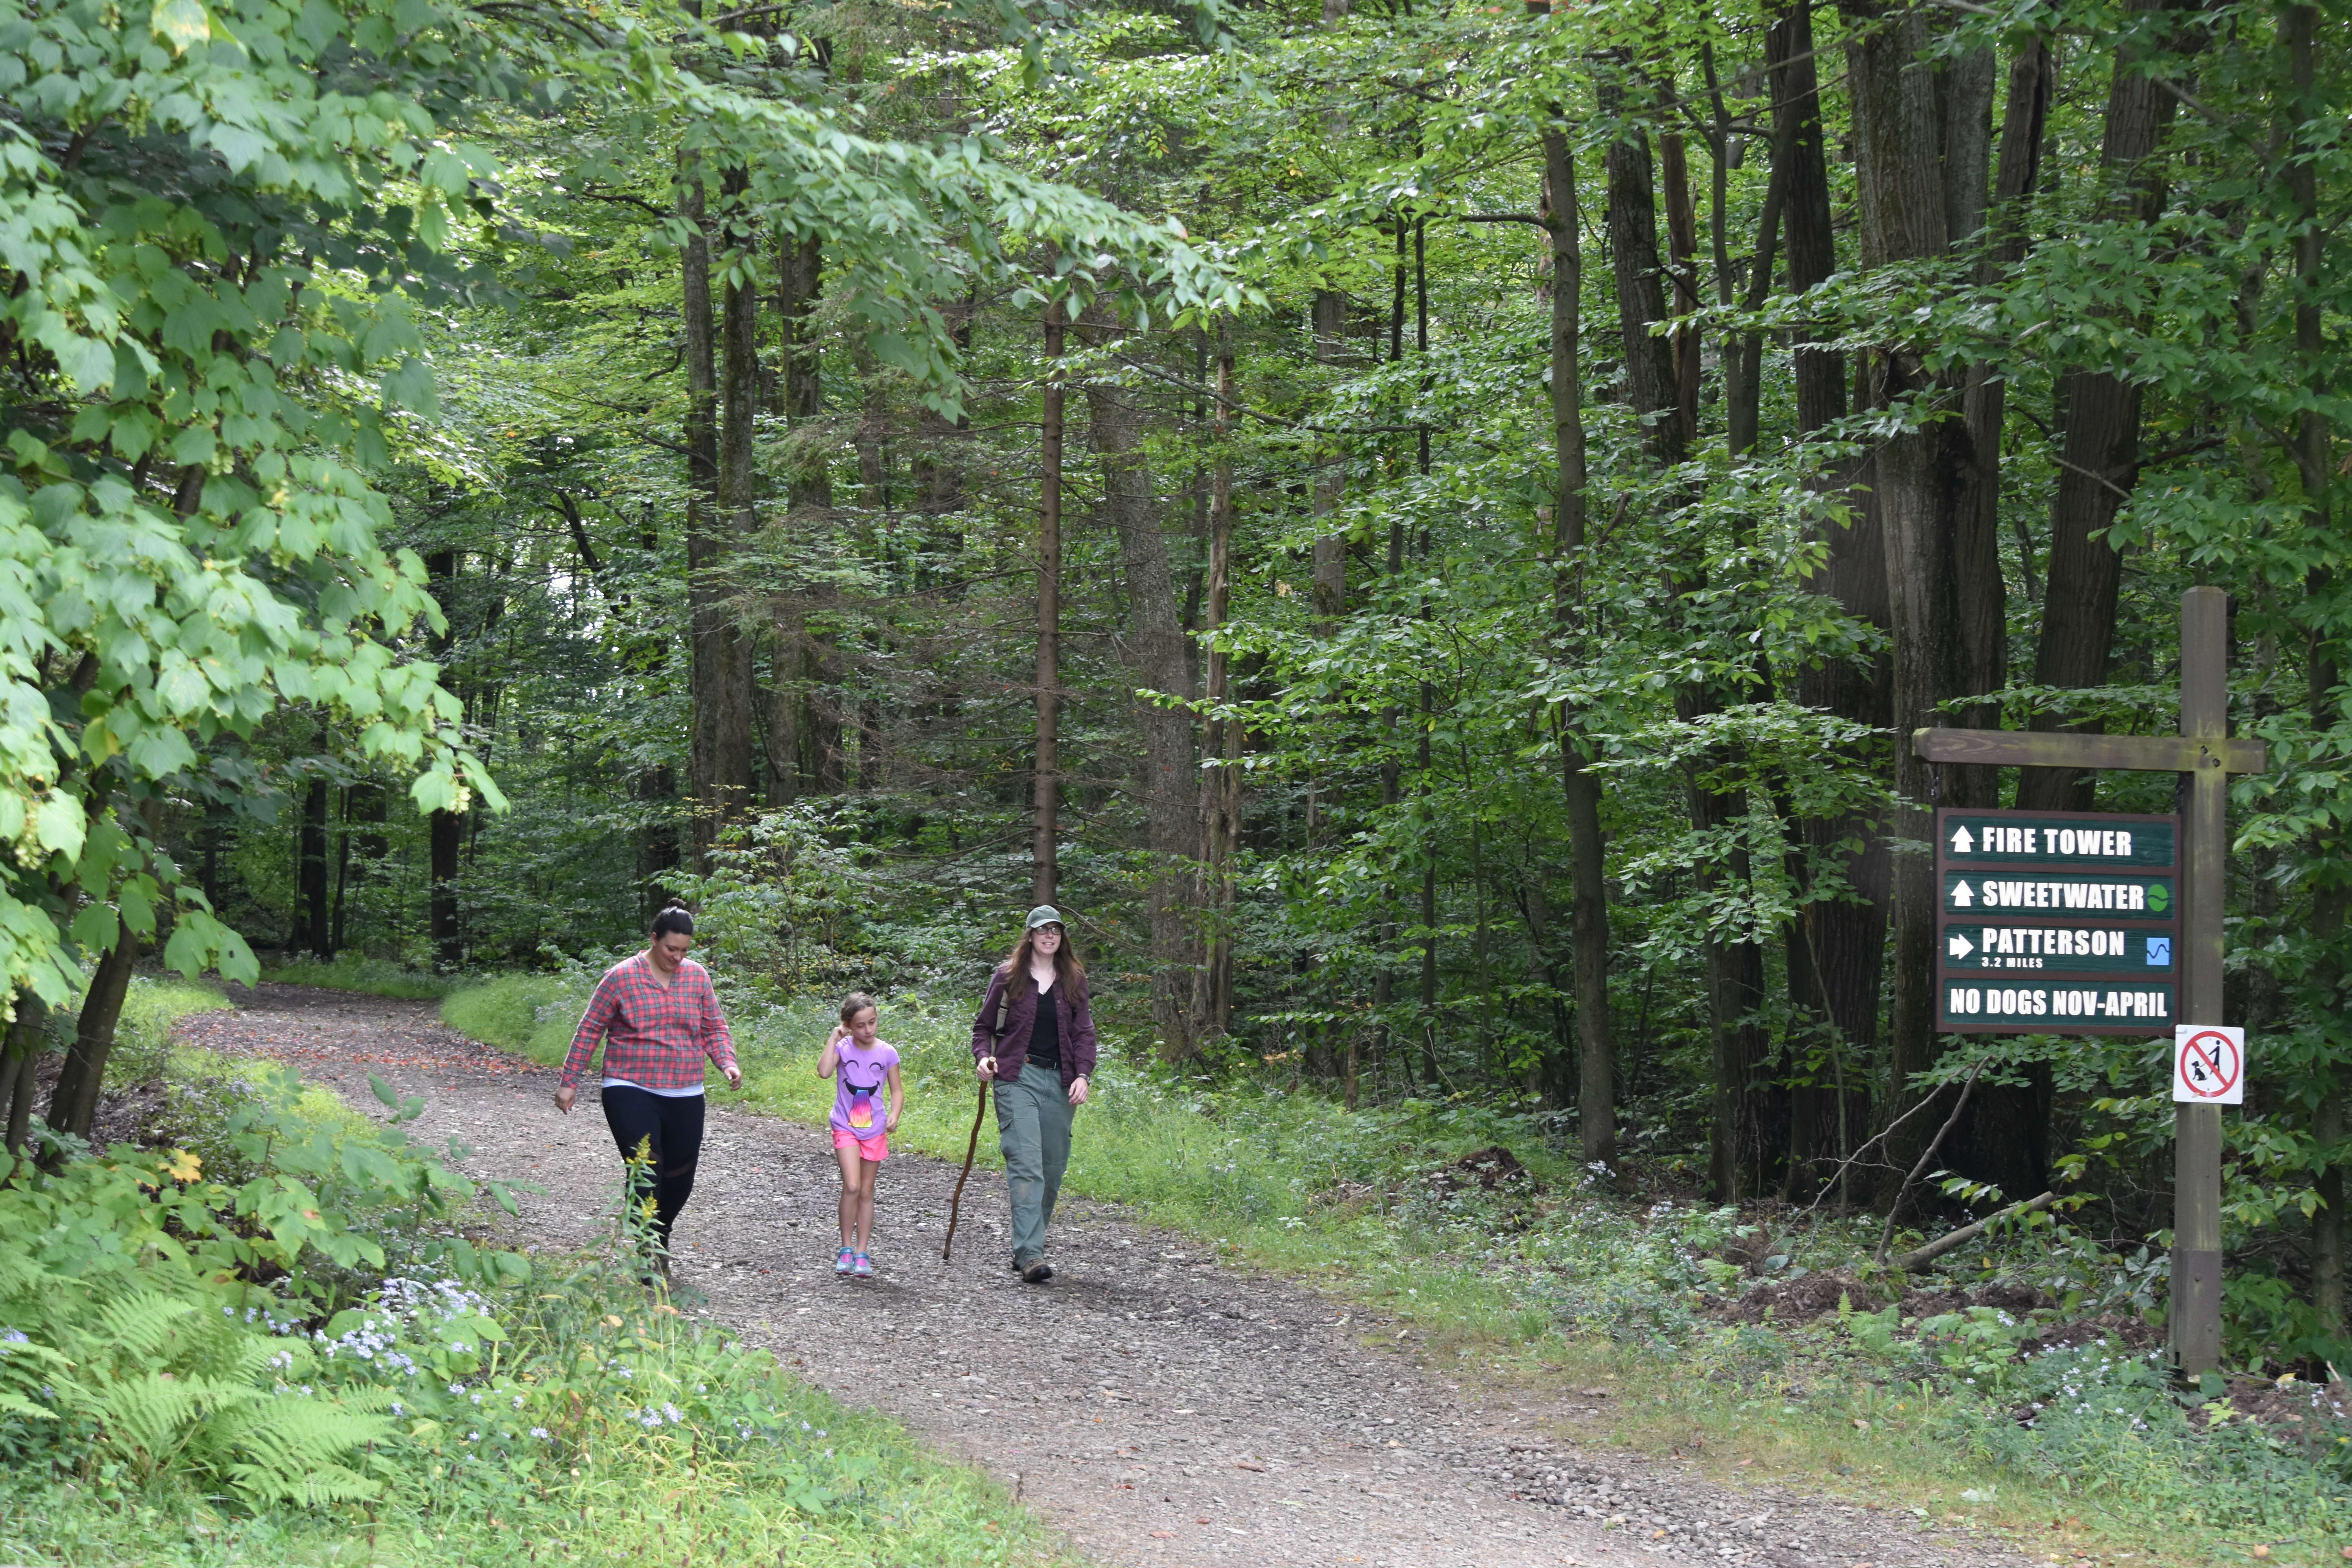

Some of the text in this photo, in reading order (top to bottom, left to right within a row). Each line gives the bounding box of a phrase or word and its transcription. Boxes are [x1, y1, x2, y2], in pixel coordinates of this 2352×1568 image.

[1983, 827, 2131, 856] FIRE TOWER
[1982, 880, 2144, 910] SWEETWATER
[1983, 928, 2124, 956] PATTERSON
[1982, 957, 2043, 968] 3.2 MILES
[1950, 988, 2167, 1017] NO DOGS NOV-APRIL
